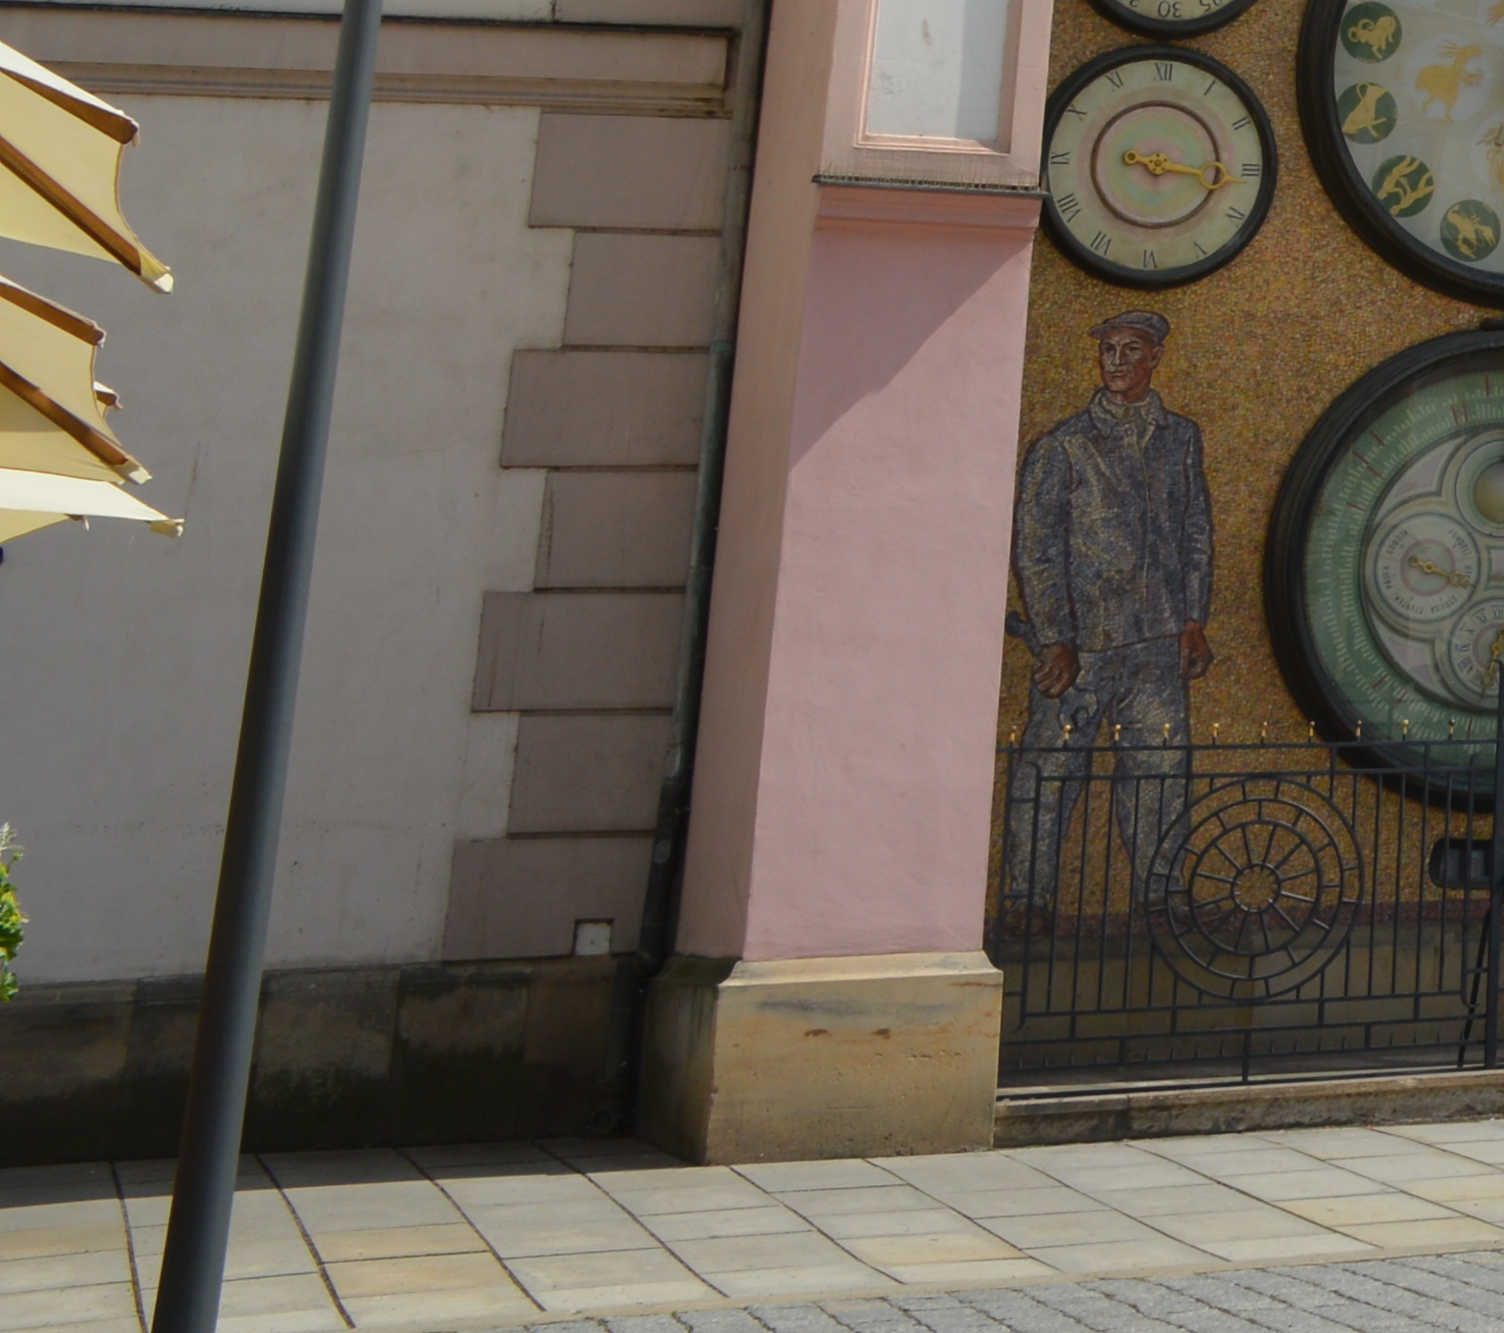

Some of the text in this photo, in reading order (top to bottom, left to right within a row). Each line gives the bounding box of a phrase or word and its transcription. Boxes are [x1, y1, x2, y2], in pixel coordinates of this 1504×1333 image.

[1157, 0, 1183, 19] 30
[1105, 70, 1124, 92] XI
[1153, 62, 1173, 82] XII
[1204, 79, 1216, 96] I
[1066, 104, 1087, 121] X
[1232, 116, 1250, 131] II
[1050, 151, 1070, 165] IX
[1241, 163, 1260, 177] III
[1057, 193, 1081, 223] VIII
[1226, 206, 1245, 227] IV
[1090, 231, 1112, 256] VII
[1194, 241, 1208, 259] V
[1142, 249, 1158, 269] VI
